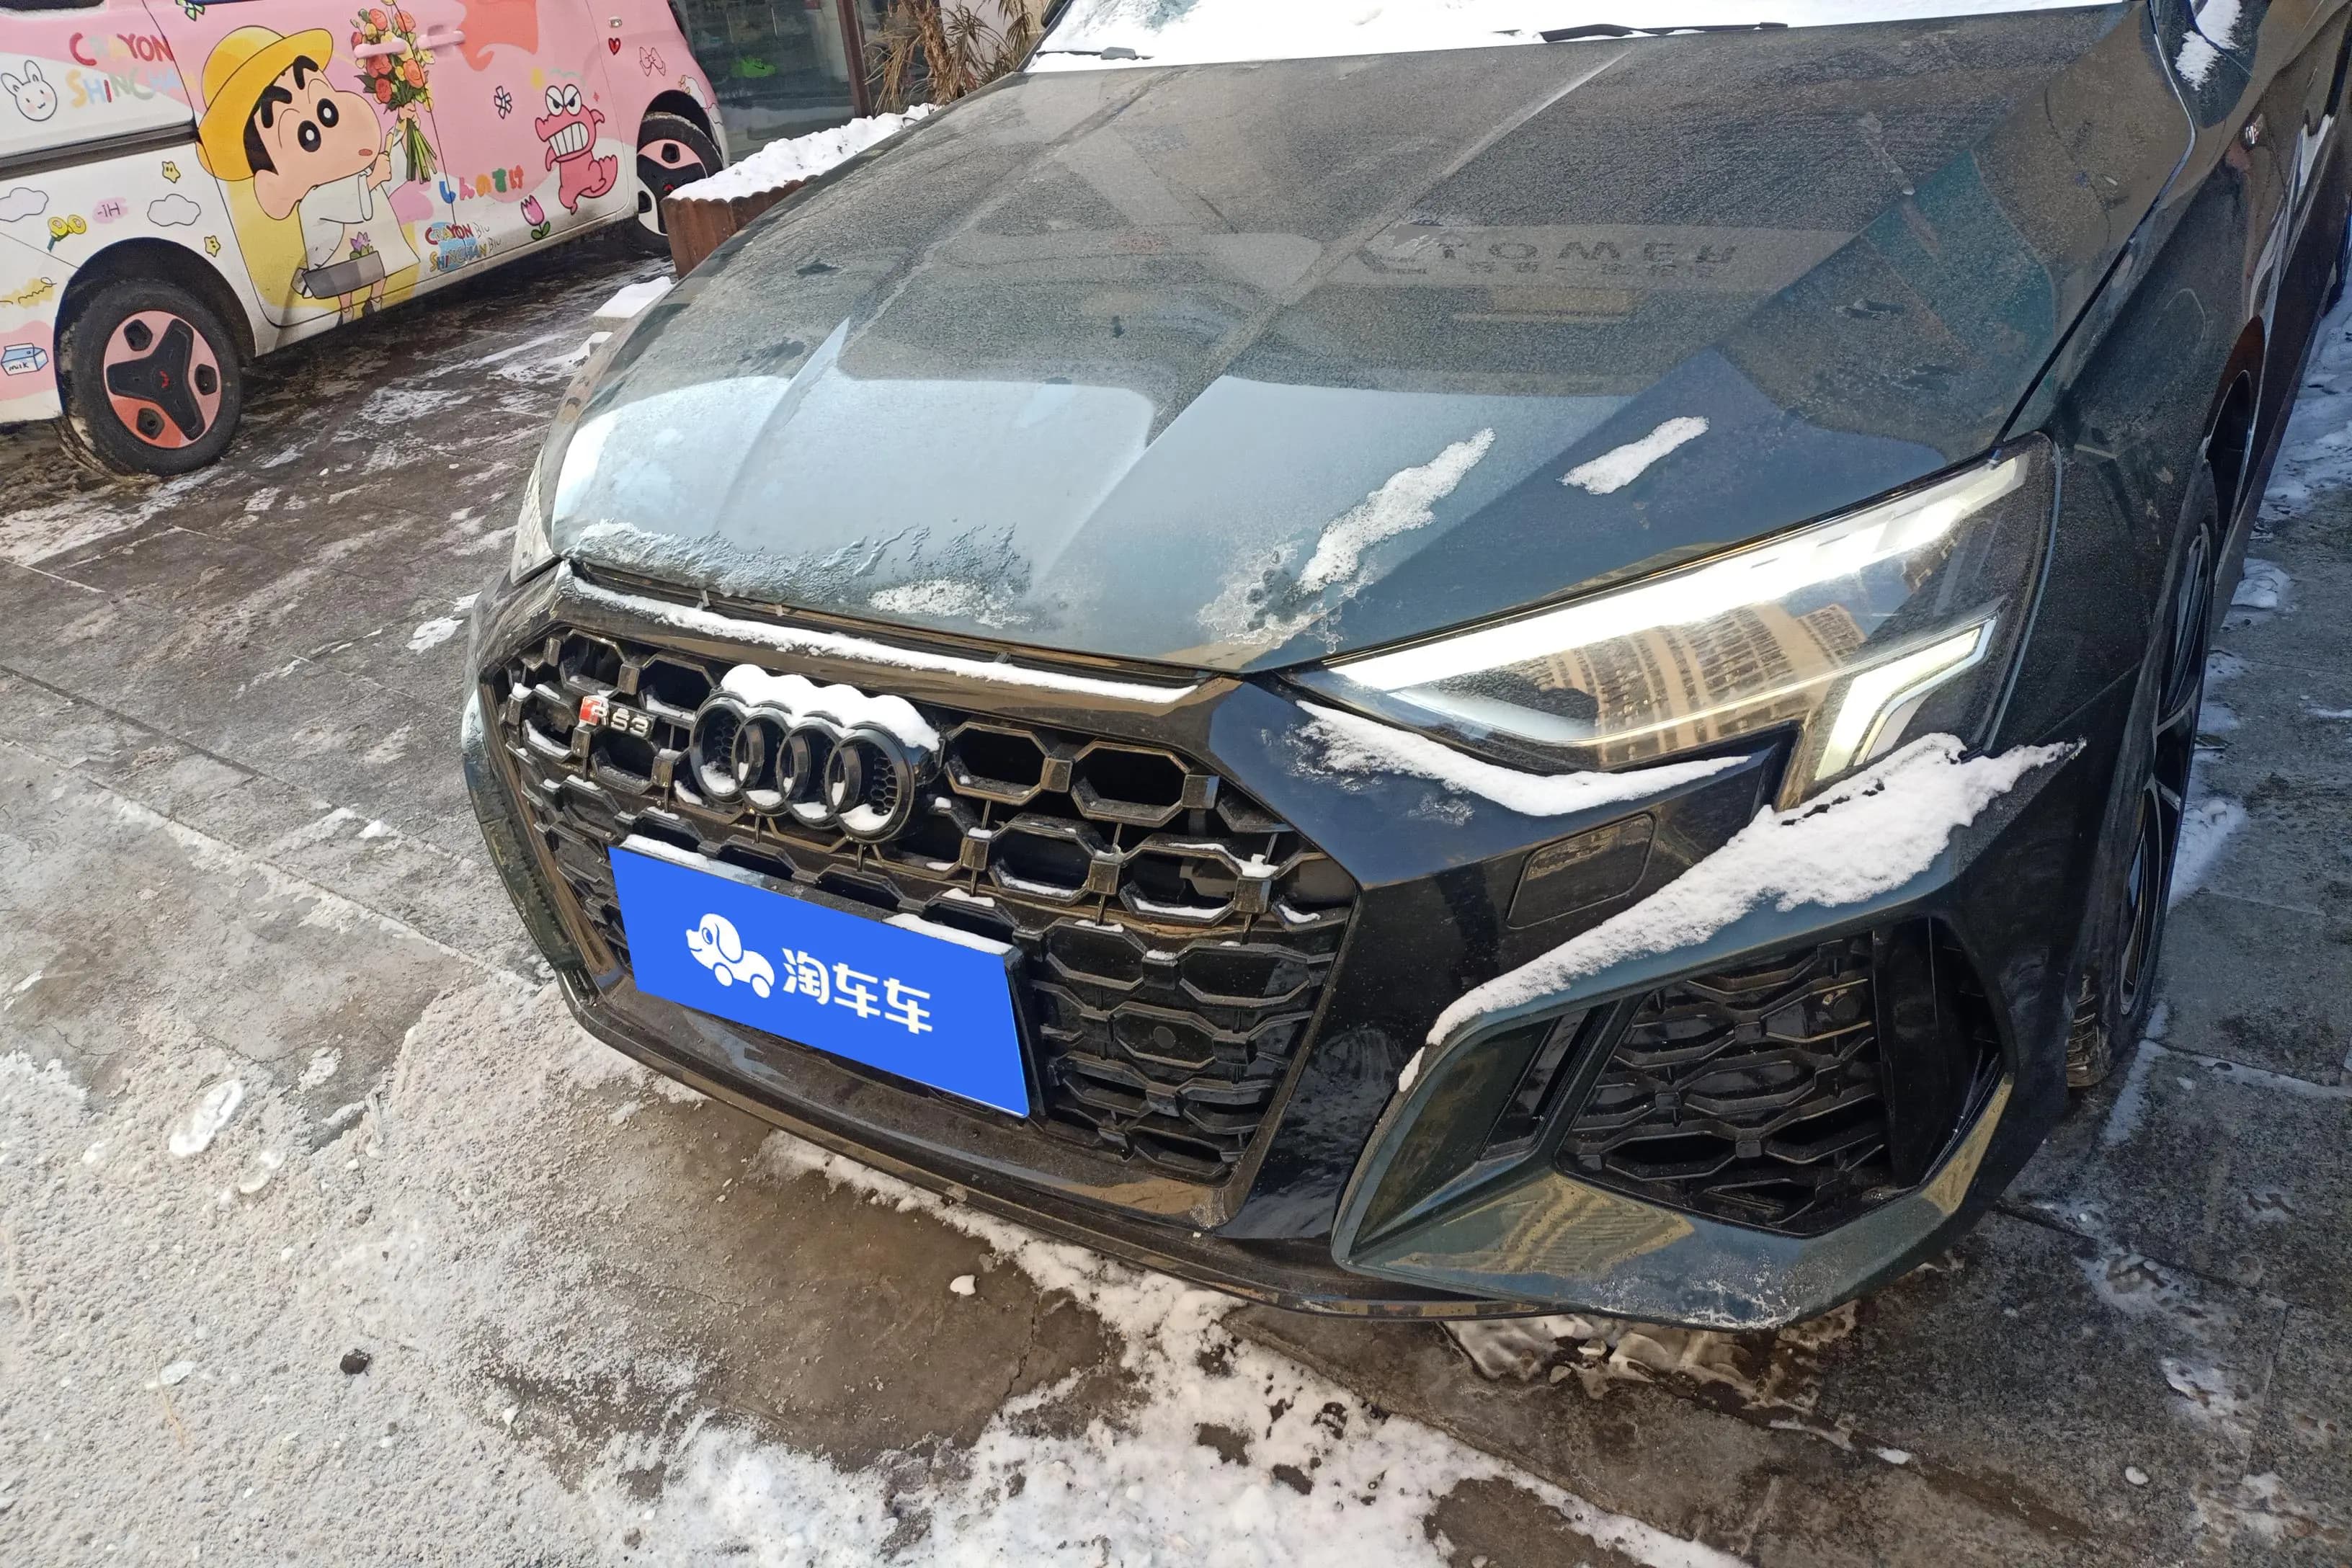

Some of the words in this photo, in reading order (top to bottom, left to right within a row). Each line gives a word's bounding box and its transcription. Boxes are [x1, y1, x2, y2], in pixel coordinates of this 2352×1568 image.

[439, 164, 524, 204] しんのすけ
[425, 223, 474, 245] CRAYON
[429, 244, 487, 272] SHINCHAN
[590, 703, 649, 737] RS3
